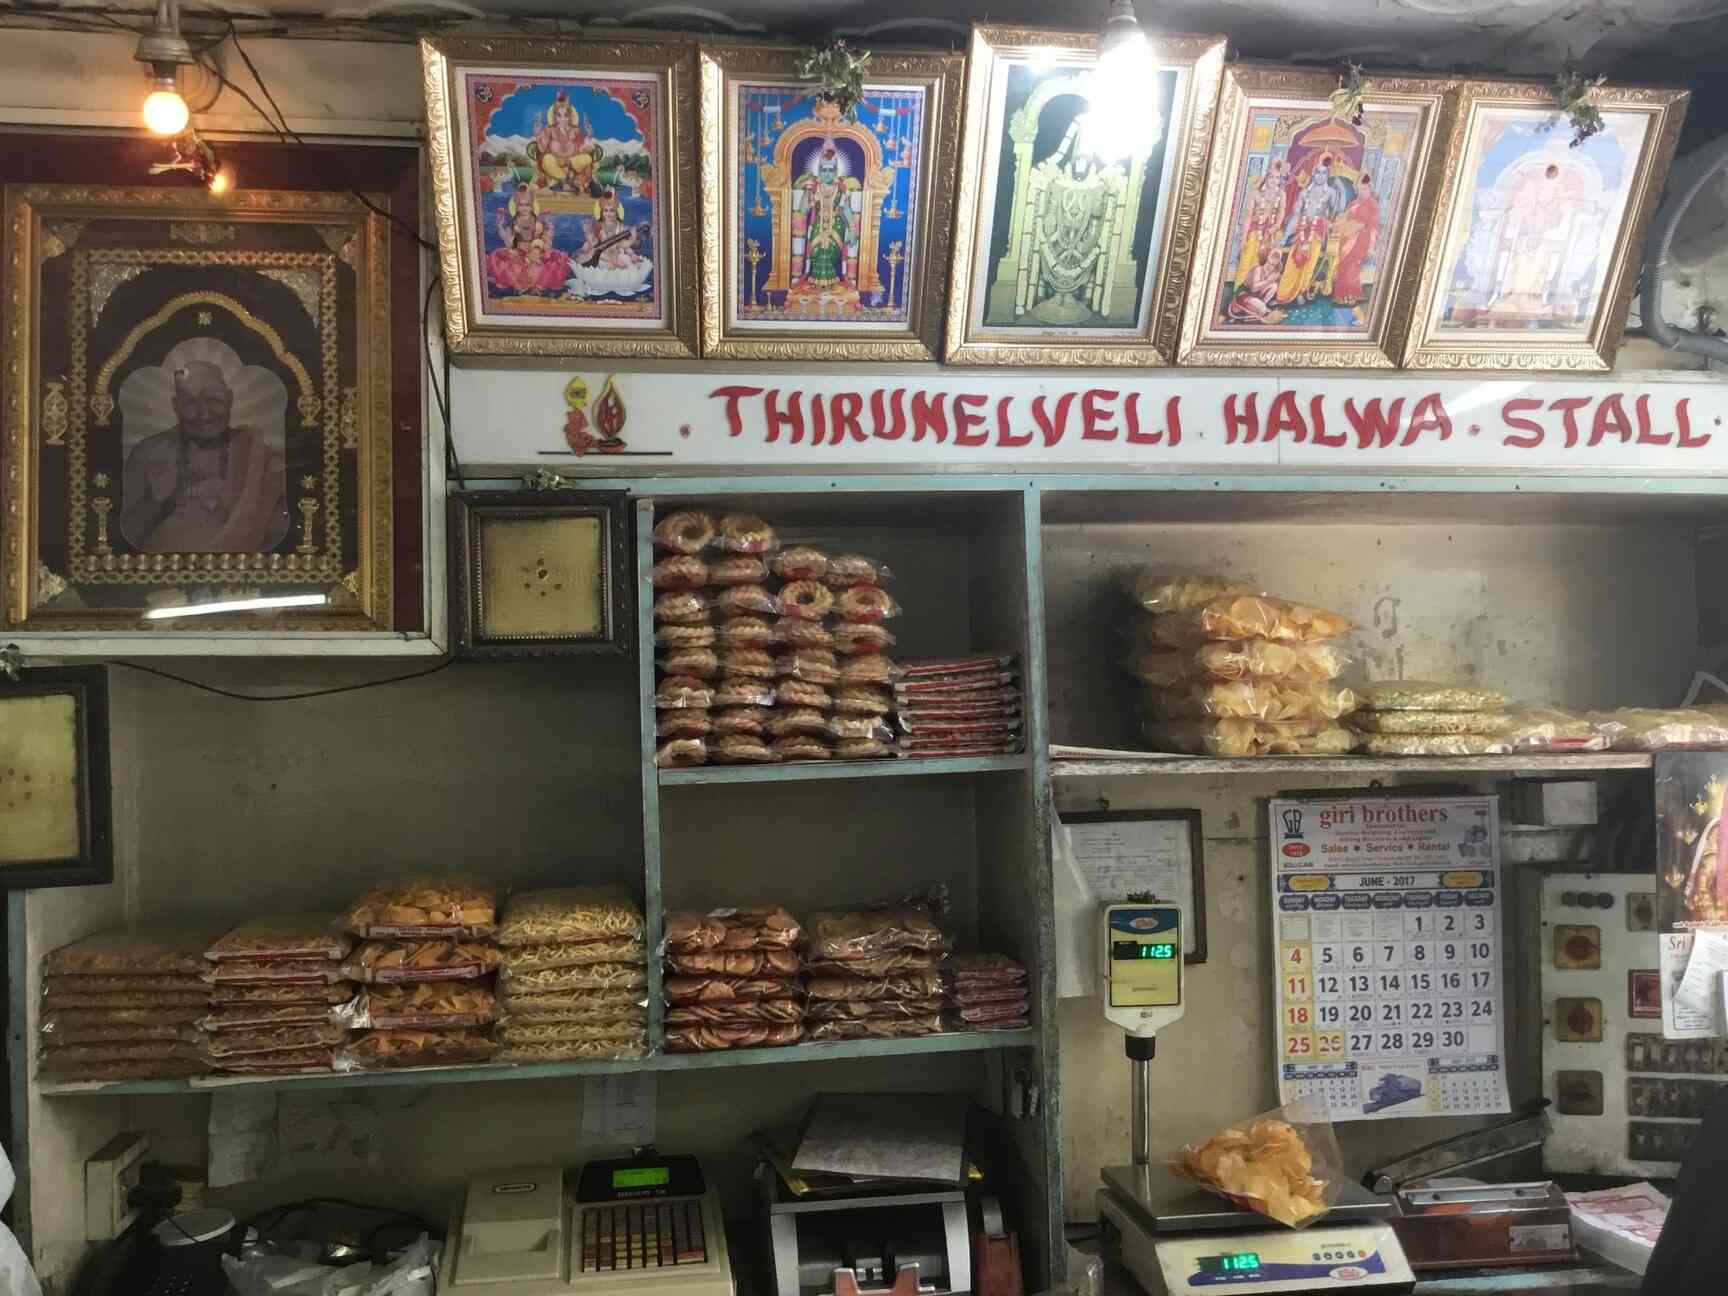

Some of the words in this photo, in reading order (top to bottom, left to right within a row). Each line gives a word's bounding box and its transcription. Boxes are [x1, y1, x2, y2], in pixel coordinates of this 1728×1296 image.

[709, 385, 1181, 448] THIRUNELVELI
[1224, 390, 1453, 449] HALWA
[1502, 393, 1711, 449] STALL
[1362, 805, 1448, 823] brothers
[1321, 843, 1348, 853] Sales
[1366, 843, 1403, 852] Service
[1360, 876, 1384, 887] JUNE
[1393, 875, 1416, 886] 2017
[1415, 916, 1422, 932] 1
[1443, 915, 1455, 931] 2
[1474, 914, 1485, 930] 3
[1290, 948, 1302, 964] 4
[1322, 947, 1333, 963] 5
[1352, 946, 1364, 962] 6
[1383, 945, 1394, 961] 7
[1414, 944, 1425, 961] 8
[1444, 944, 1455, 960] 9
[1470, 943, 1490, 959] 10
[1288, 977, 1306, 994] 11
[1318, 977, 1339, 993] 12
[1349, 976, 1369, 992] 13
[1379, 975, 1400, 991] 14
[1411, 974, 1430, 990] 15
[1441, 973, 1460, 989] 16
[1471, 972, 1490, 988] 17
[1288, 1007, 1308, 1024] 18
[1319, 1006, 1339, 1022] 19
[1349, 1005, 1372, 1021] 20
[1382, 1004, 1401, 1020] 21
[1411, 1003, 1433, 1019] 22
[1441, 1002, 1463, 1018] 23
[1471, 1000, 1492, 1017] 24
[1288, 1037, 1310, 1053] 25
[1319, 1036, 1341, 1052] 26
[1350, 1034, 1372, 1051] 27
[1380, 1033, 1403, 1050] 28
[1411, 1032, 1434, 1048] 29
[1442, 1031, 1464, 1047] 30
